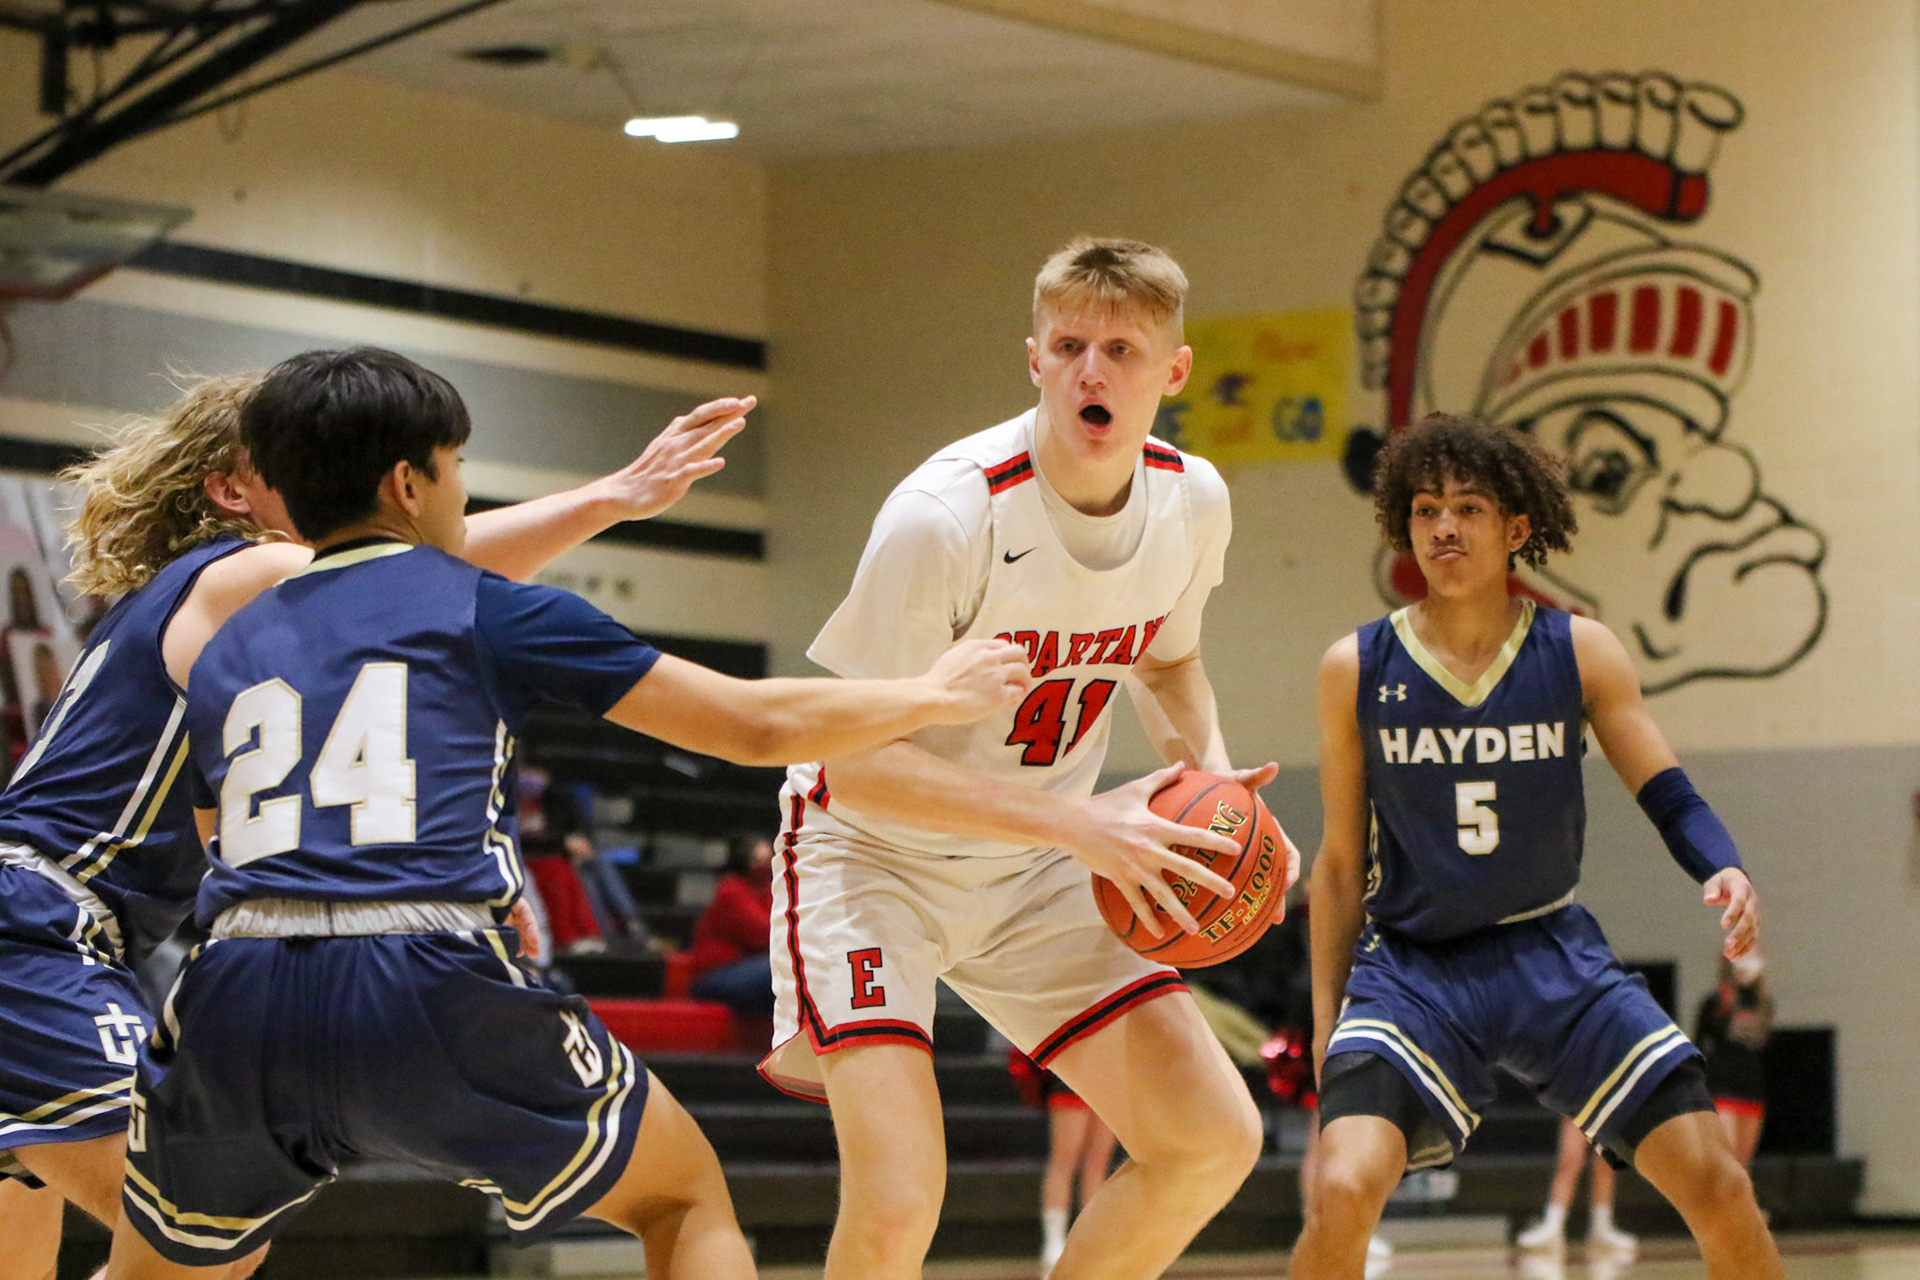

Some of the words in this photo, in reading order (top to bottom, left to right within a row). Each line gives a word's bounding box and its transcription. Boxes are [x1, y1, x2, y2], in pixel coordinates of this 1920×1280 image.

[1004, 678, 1118, 767] 41
[1378, 722, 1565, 764] HAYDEN
[219, 661, 417, 869] 24
[1455, 781, 1500, 856] 5
[1198, 834, 1277, 943] TF-1000
[846, 947, 887, 1011] E
